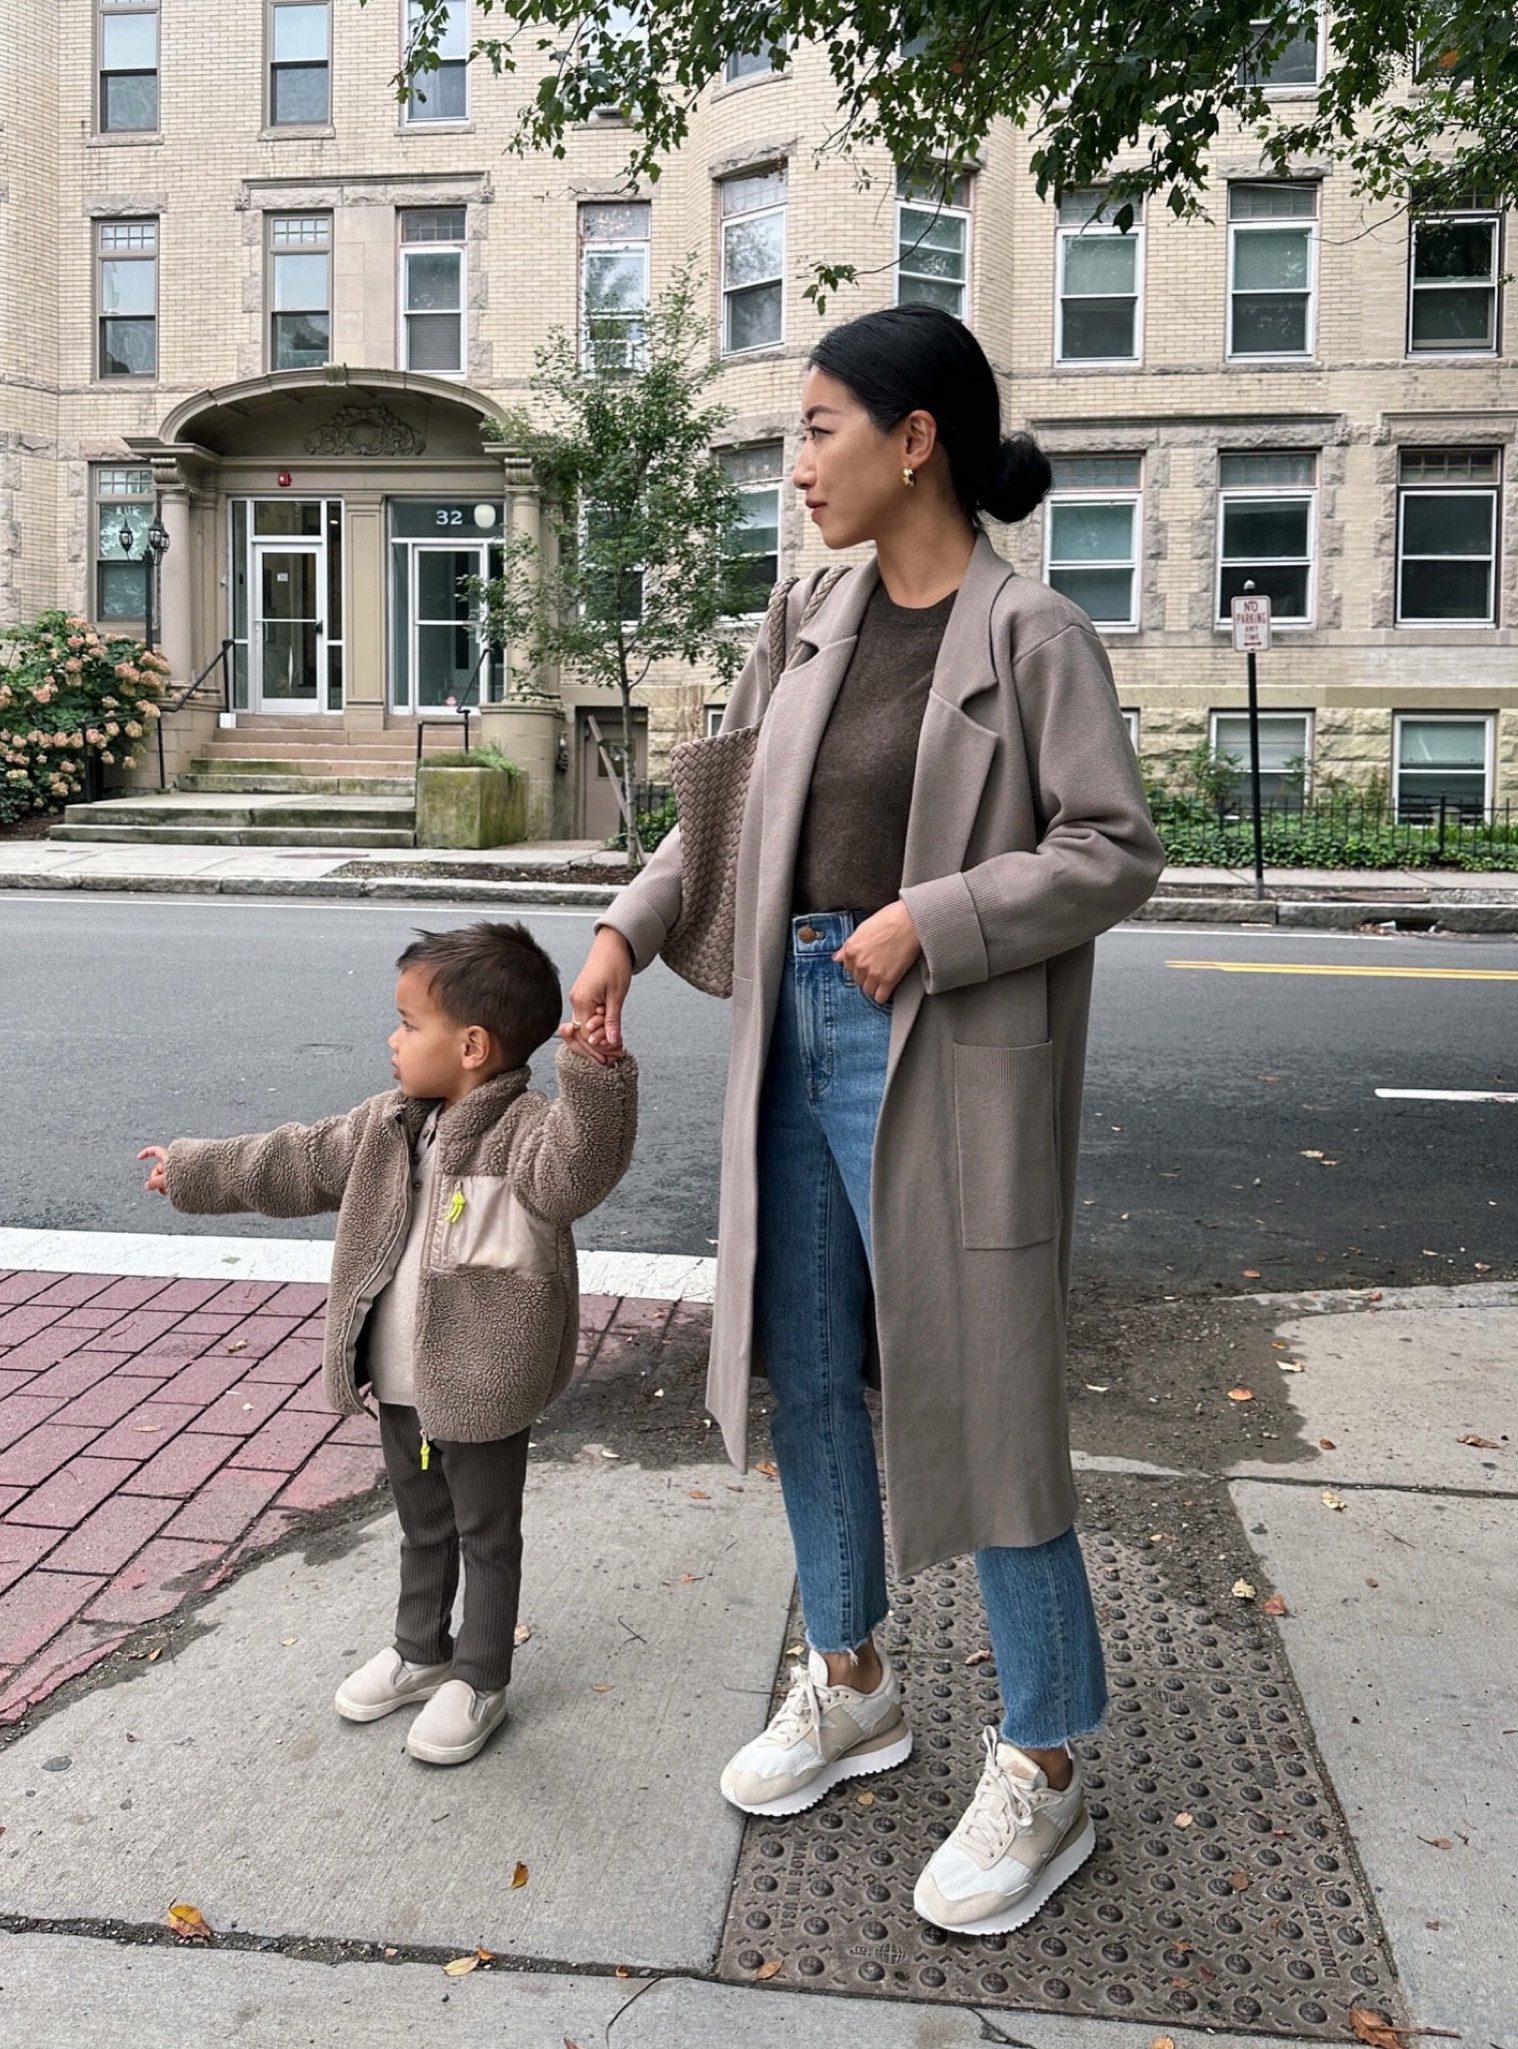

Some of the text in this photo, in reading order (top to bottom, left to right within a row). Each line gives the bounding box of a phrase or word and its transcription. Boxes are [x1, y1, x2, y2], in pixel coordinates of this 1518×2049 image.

[436, 510, 463, 525] 32
[1244, 601, 1258, 612] NO
[1236, 612, 1267, 624] PARKING
[780, 1840, 808, 1930] MADE IN USA
